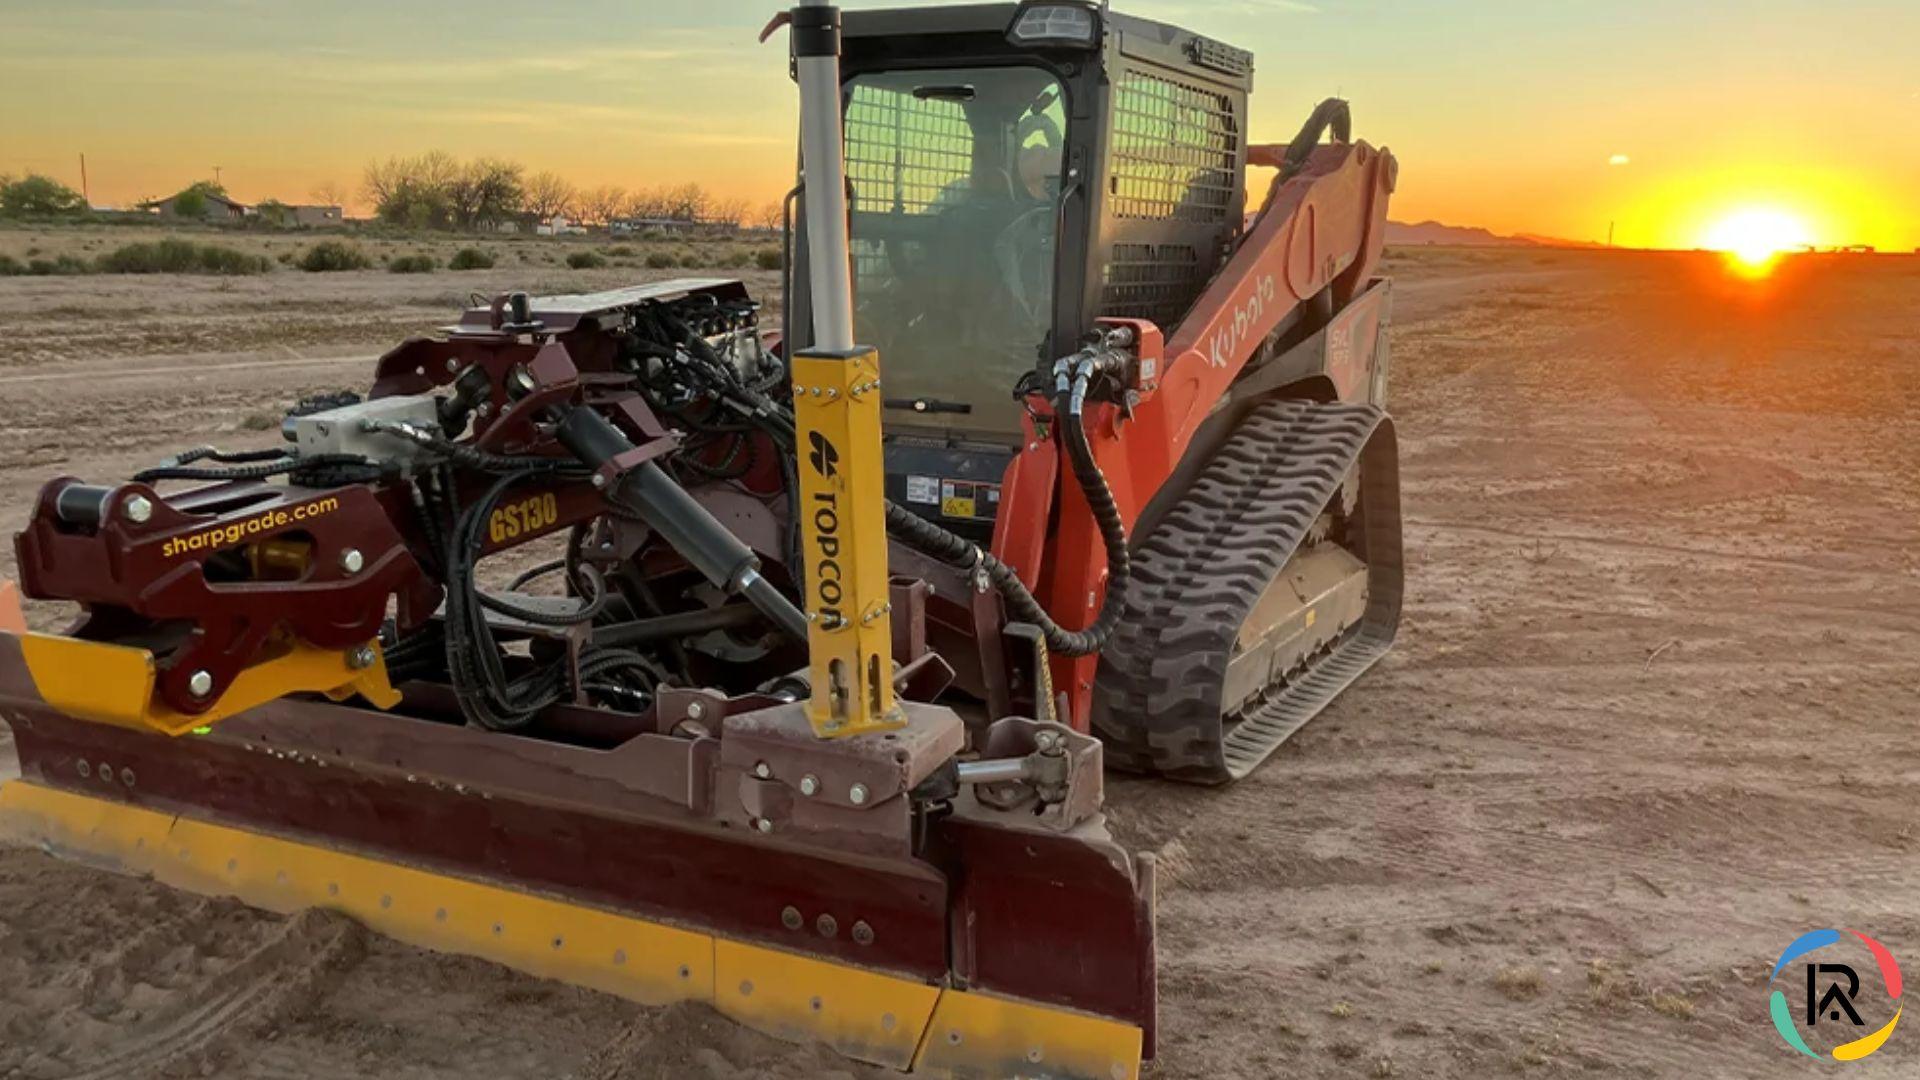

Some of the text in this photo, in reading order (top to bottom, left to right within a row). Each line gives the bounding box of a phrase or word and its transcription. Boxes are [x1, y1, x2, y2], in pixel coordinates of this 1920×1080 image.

[1210, 274, 1274, 369] Kubota
[163, 497, 338, 557] sharpgrade.com
[490, 492, 557, 543] GS130
[814, 493, 841, 630] TOPCON
